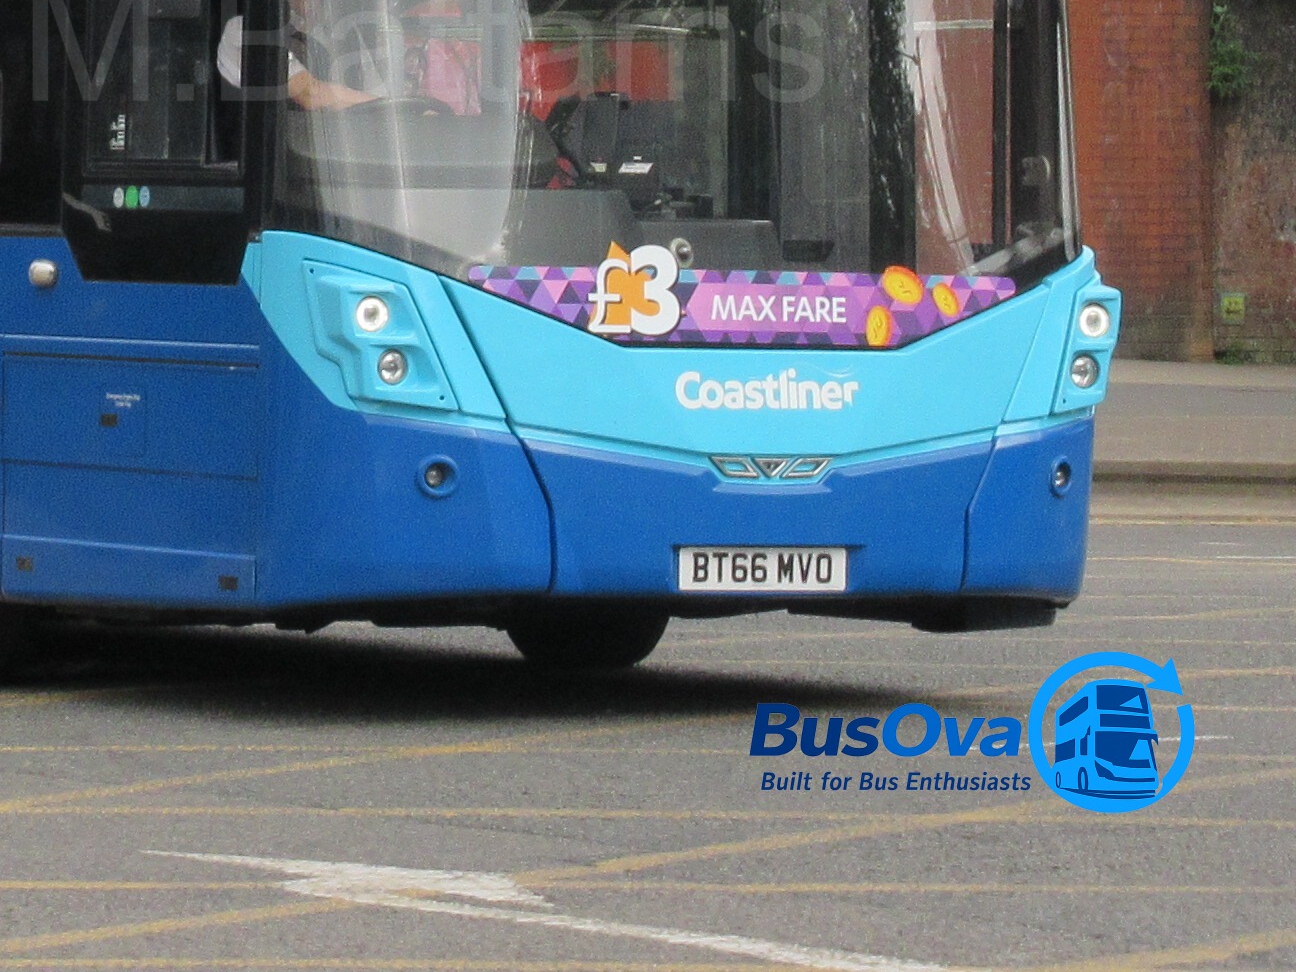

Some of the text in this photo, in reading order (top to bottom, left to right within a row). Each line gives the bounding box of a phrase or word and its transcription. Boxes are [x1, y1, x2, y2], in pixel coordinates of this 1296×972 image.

[588, 244, 847, 335] £3 MAX FARE
[675, 367, 859, 410] Coastliner
[692, 552, 833, 585] BT66 MVO
